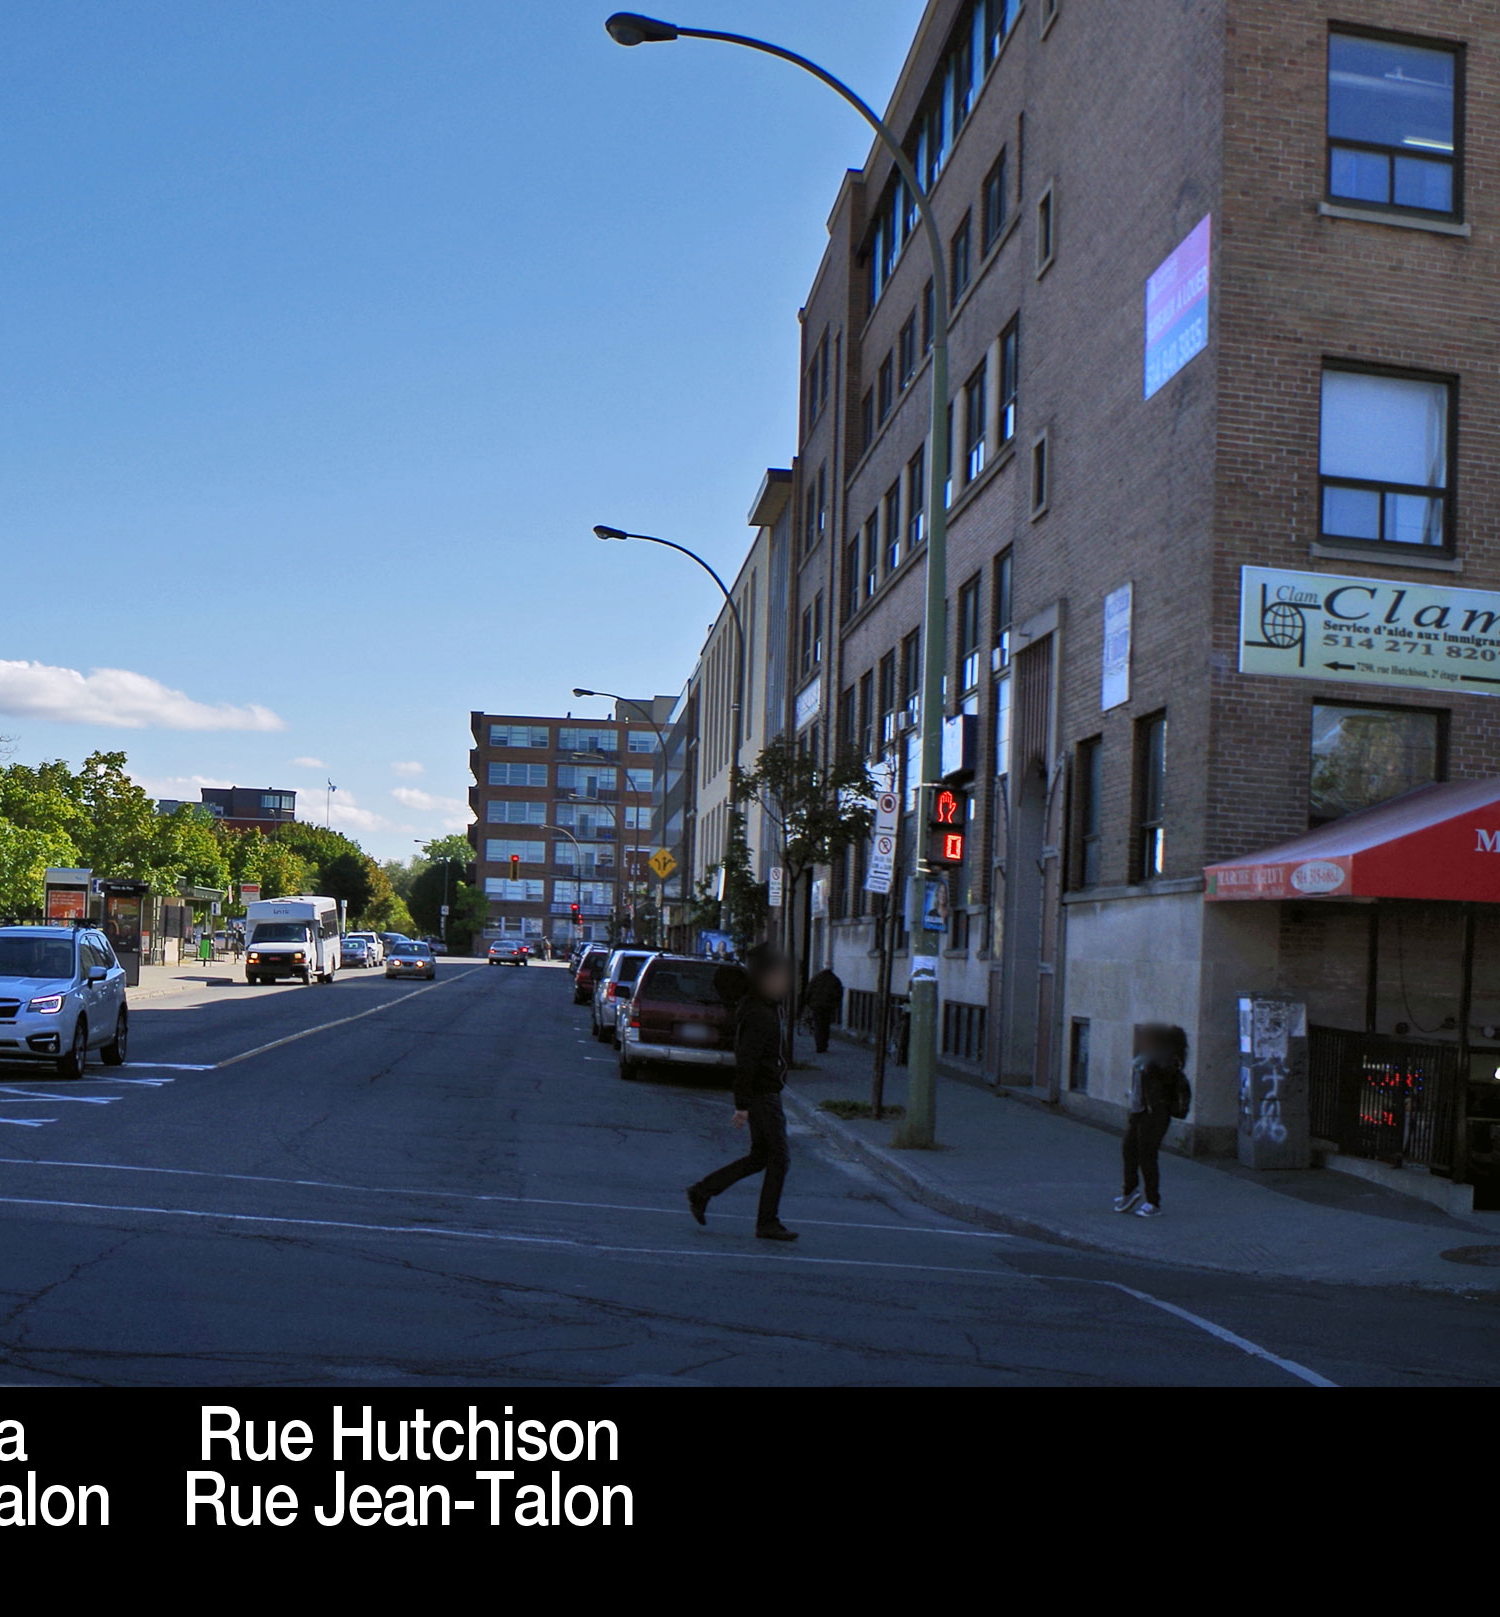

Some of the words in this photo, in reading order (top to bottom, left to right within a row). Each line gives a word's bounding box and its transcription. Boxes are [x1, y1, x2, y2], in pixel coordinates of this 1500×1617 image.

[1276, 585, 1318, 604] Clam
[1323, 620, 1371, 636] Service
[1417, 631, 1440, 642] aux
[1322, 633, 1375, 651] 514
[1384, 639, 1434, 657] 271
[1445, 645, 1500, 662] 820
[946, 834, 963, 860] 0
